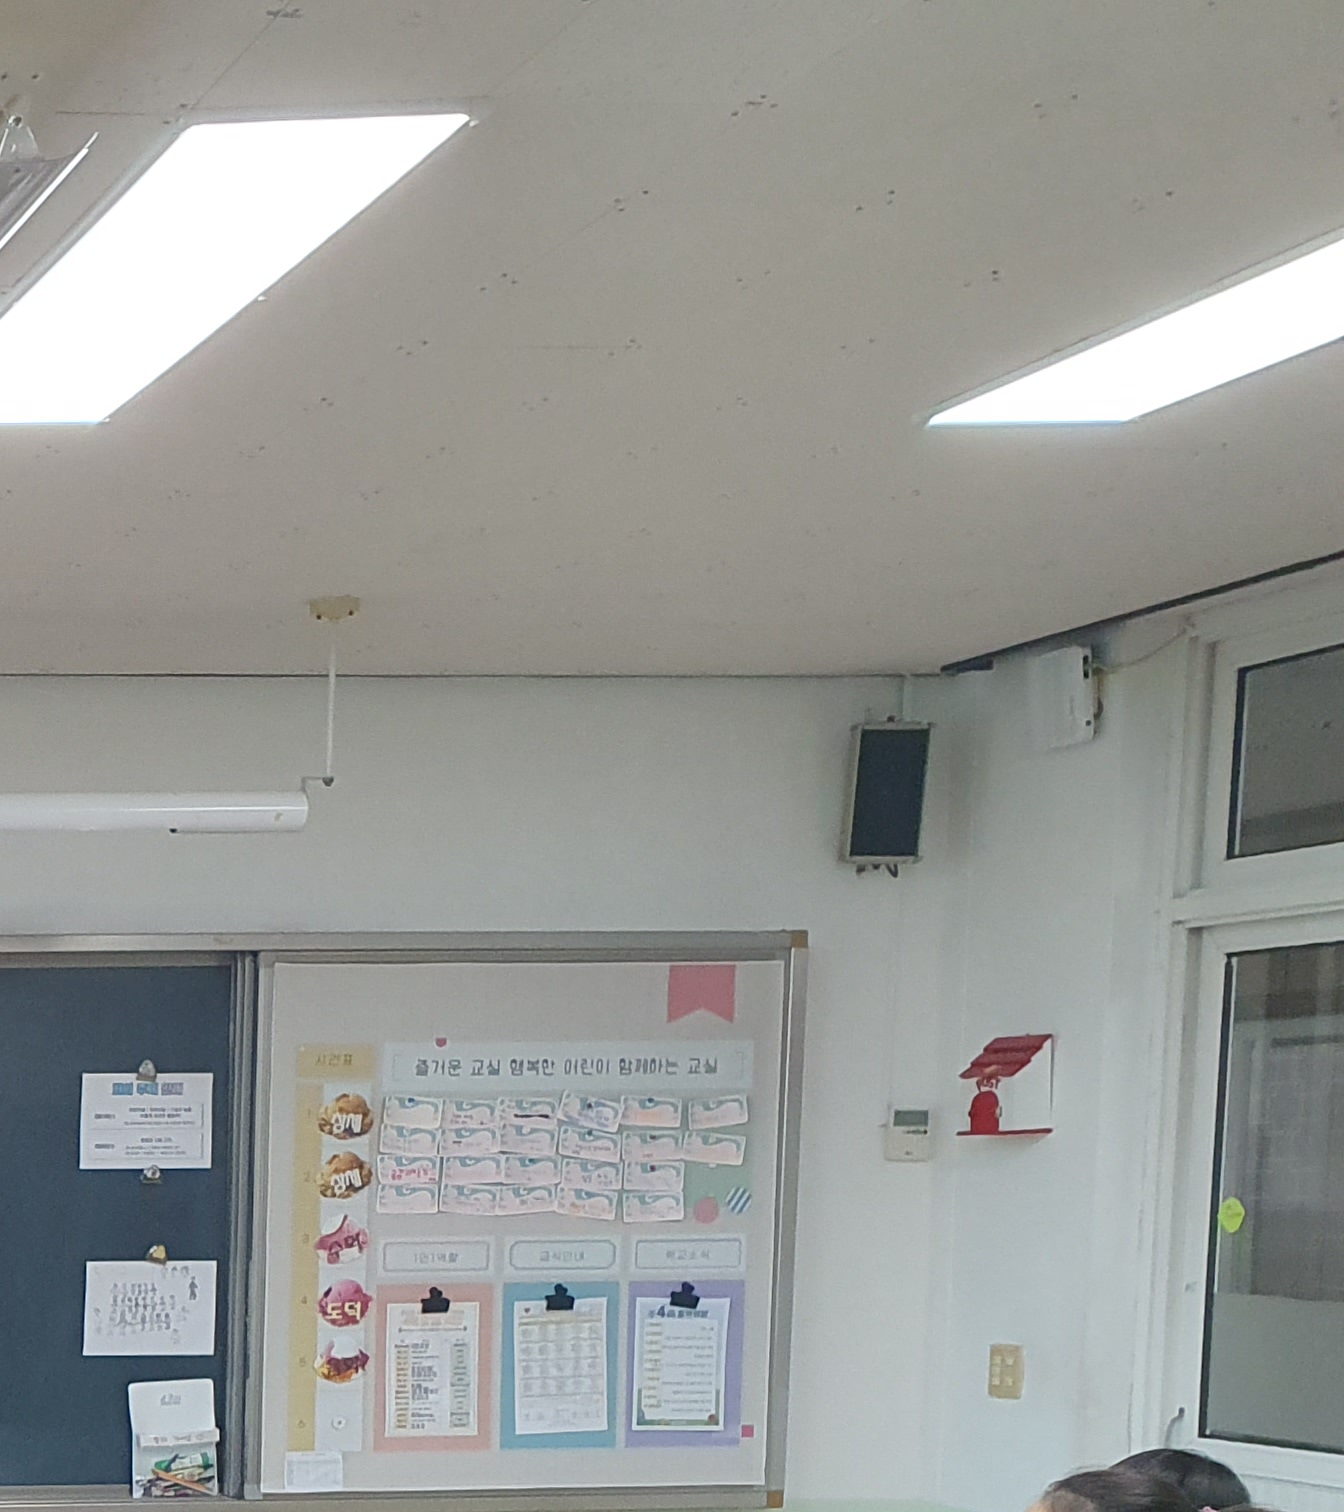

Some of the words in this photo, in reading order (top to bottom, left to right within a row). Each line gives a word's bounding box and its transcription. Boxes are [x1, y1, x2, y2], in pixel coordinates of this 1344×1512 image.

[415, 1059, 462, 1077] 즐거운
[470, 1059, 501, 1077] 교실
[564, 1058, 610, 1077] 어린이
[687, 1057, 718, 1075] 교실
[326, 1301, 362, 1320] 도덕
